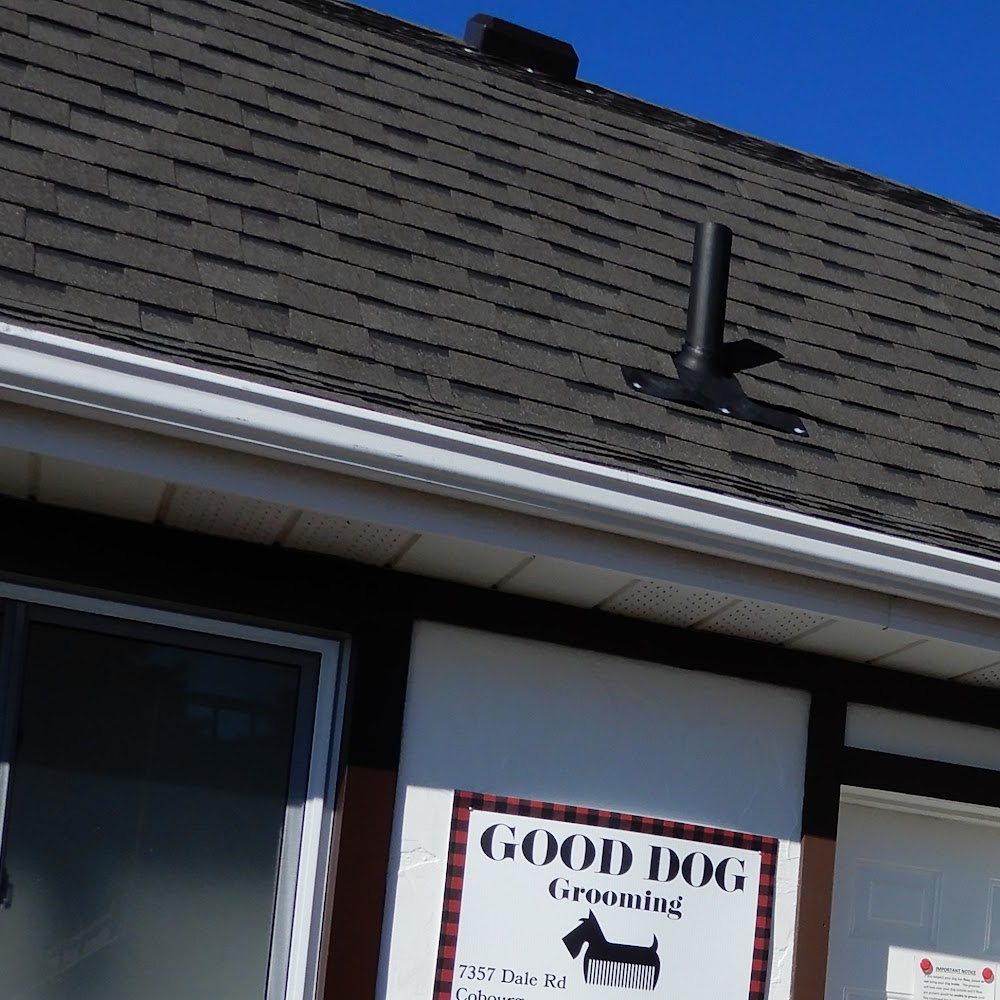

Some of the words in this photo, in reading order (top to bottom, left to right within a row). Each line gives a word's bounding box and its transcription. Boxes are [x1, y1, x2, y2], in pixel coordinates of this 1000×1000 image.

[480, 823, 633, 876] GOOD
[643, 845, 748, 893] DOG
[548, 877, 683, 920] Grooming
[458, 964, 496, 982] 7357
[500, 968, 538, 988] Dale
[543, 973, 568, 989] Rd
